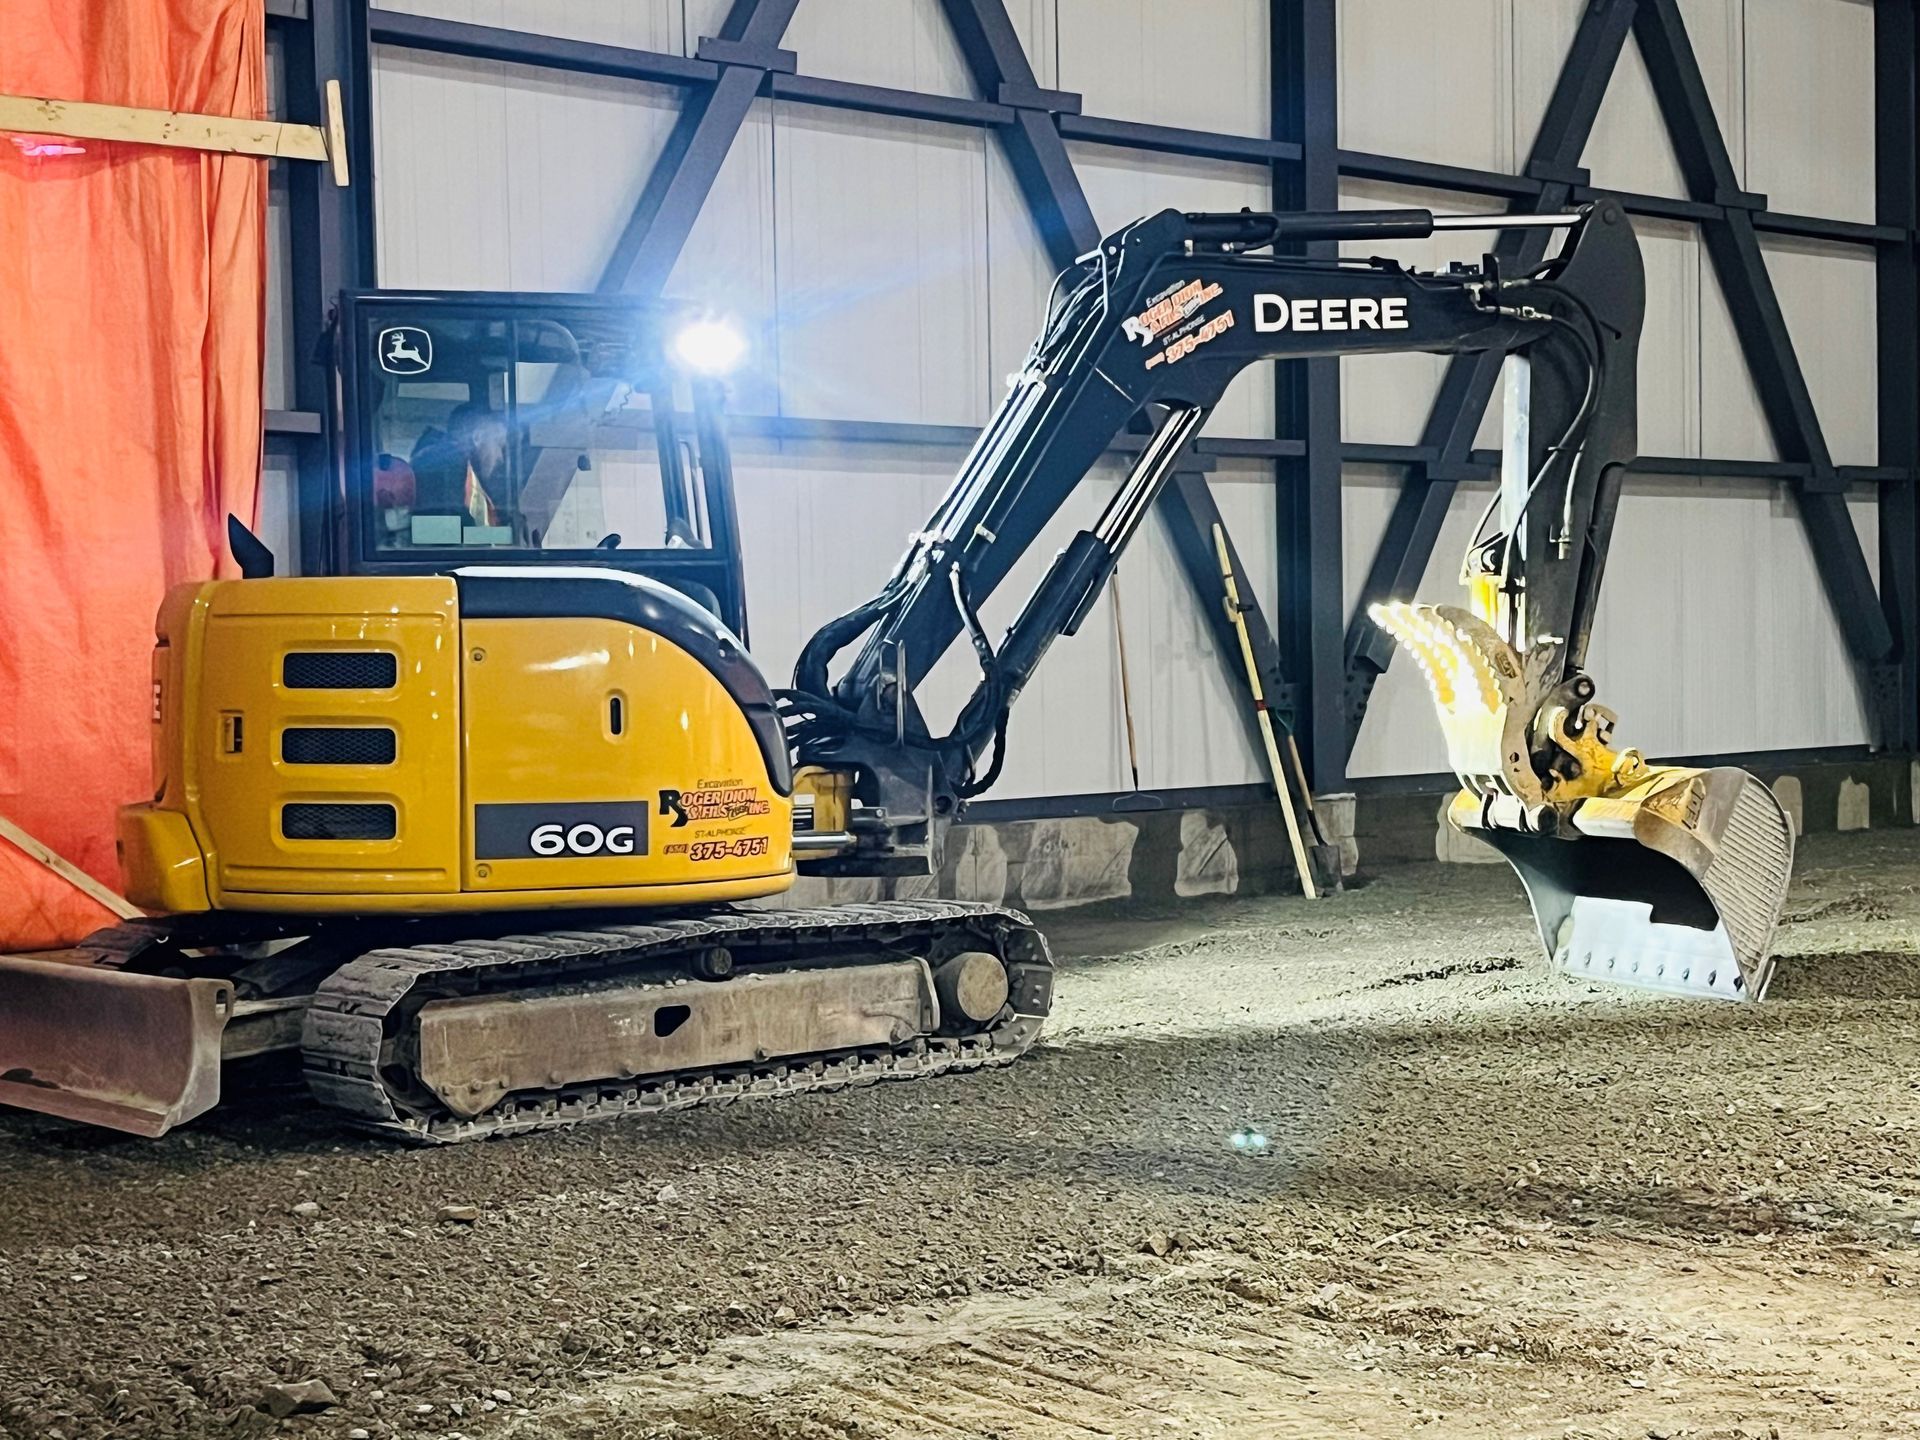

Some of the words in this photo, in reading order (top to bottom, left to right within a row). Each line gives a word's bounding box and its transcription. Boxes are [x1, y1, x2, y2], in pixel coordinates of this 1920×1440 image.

[1121, 299, 1173, 347] ROGER
[1171, 279, 1203, 306] DION
[1253, 293, 1409, 333] DEERE
[1165, 309, 1236, 364] 375-4751
[697, 779, 743, 789] Excavation
[659, 789, 722, 828] ROGER
[722, 788, 757, 804] DION
[700, 803, 729, 819] FILS
[530, 823, 635, 855] 60G
[689, 836, 769, 862] 375-4751
